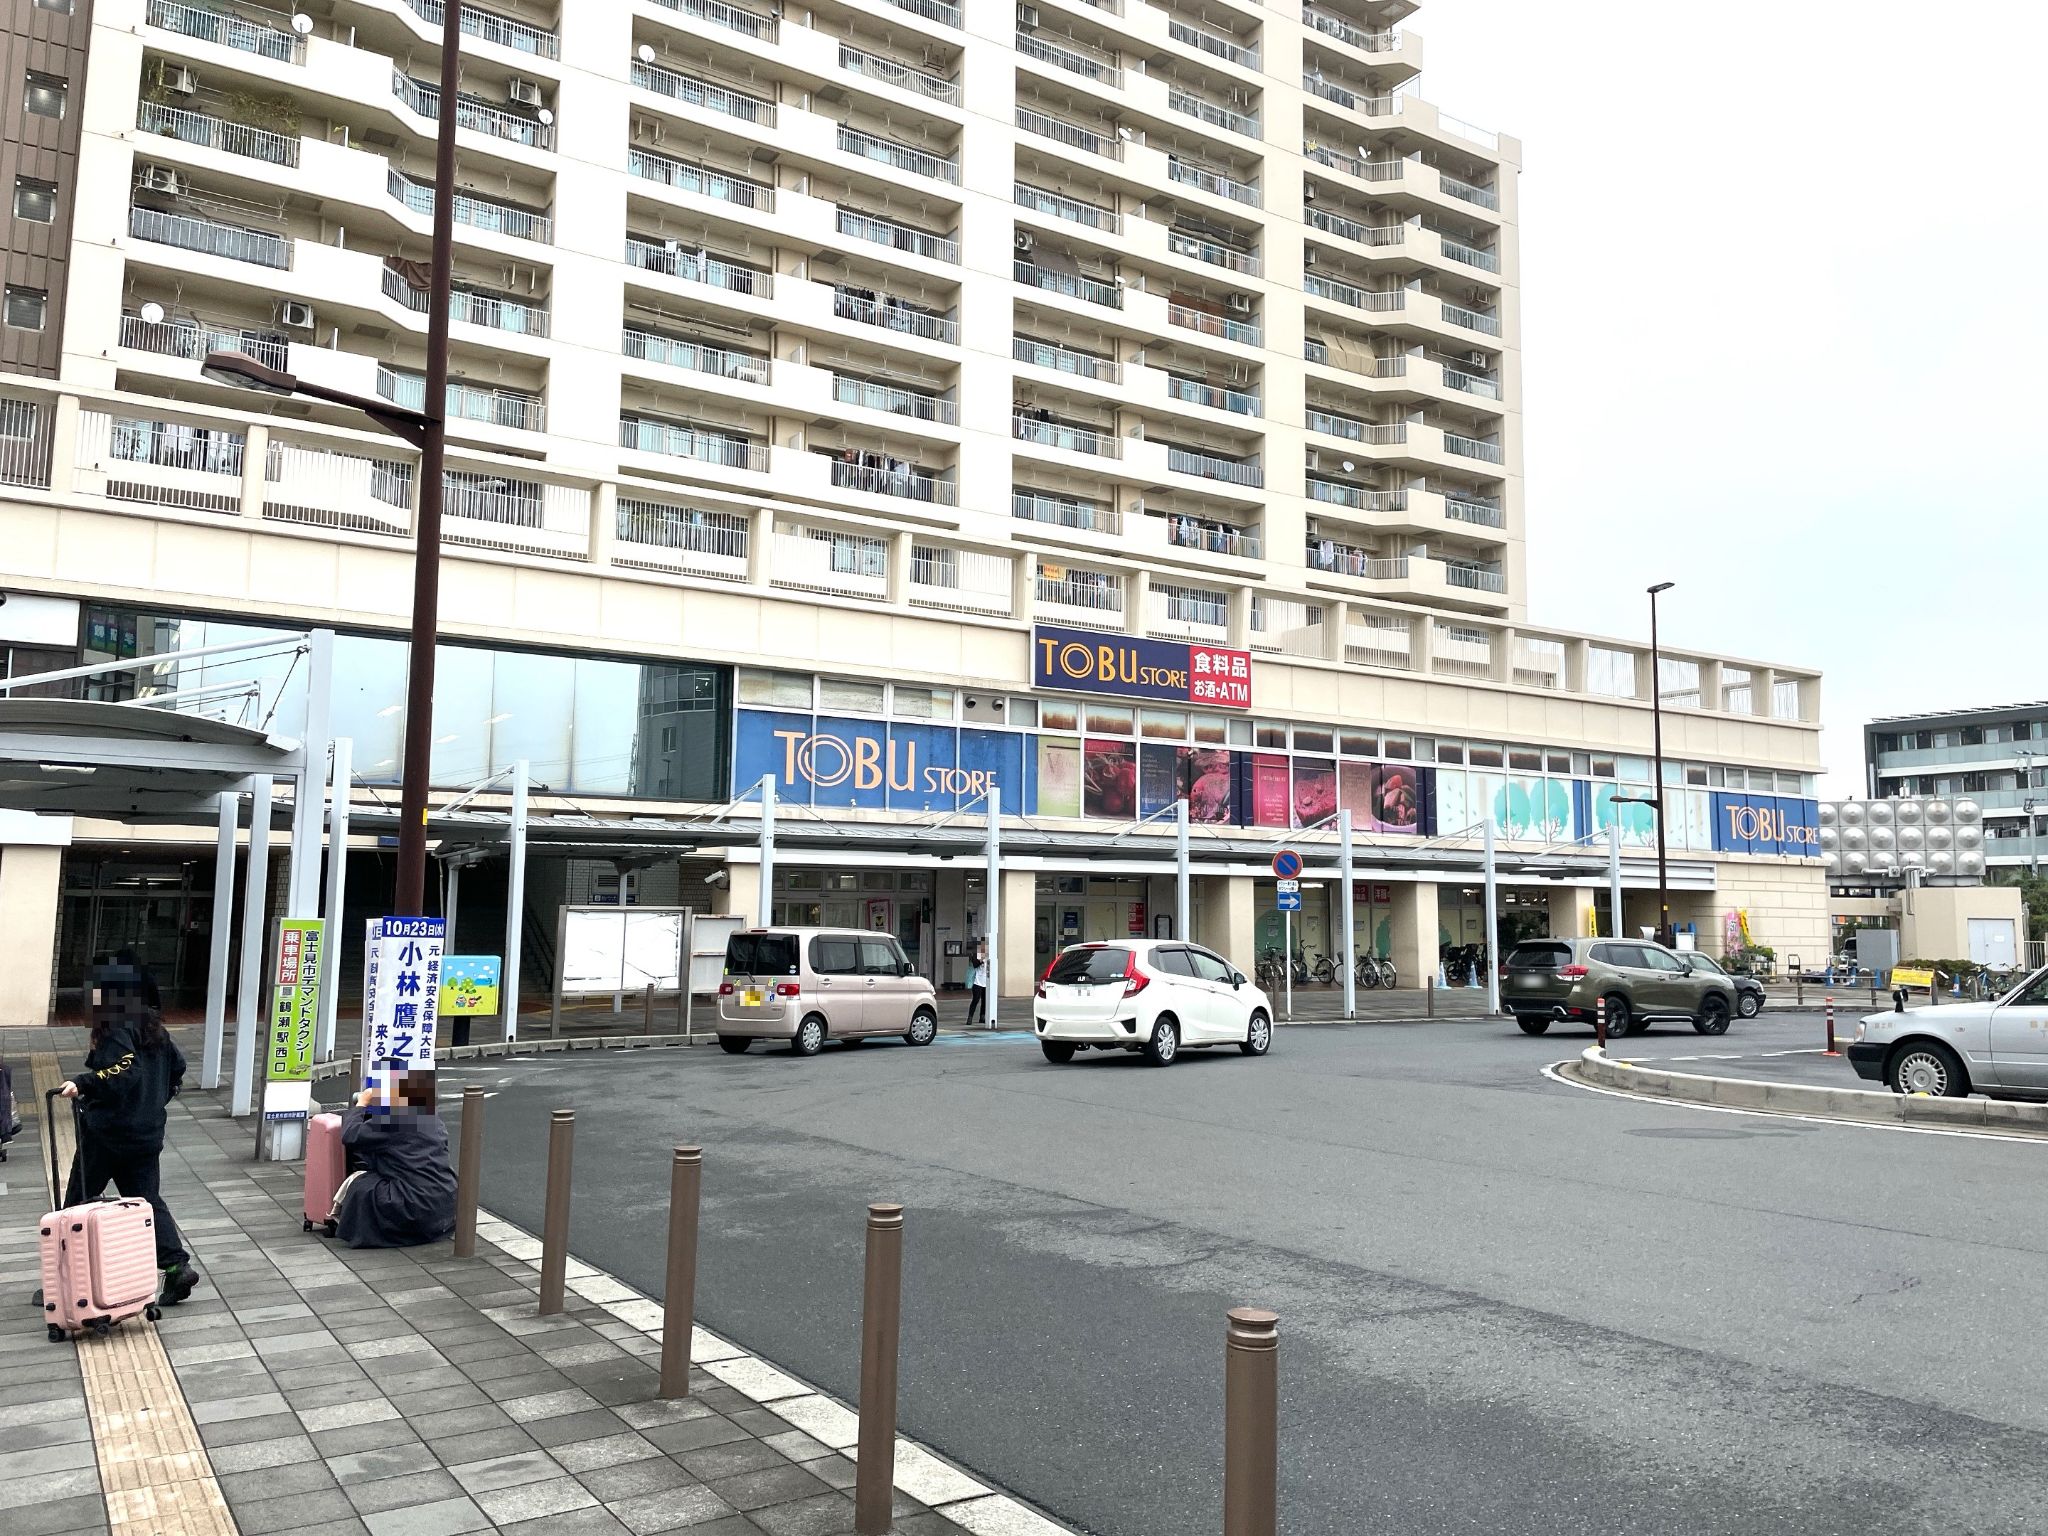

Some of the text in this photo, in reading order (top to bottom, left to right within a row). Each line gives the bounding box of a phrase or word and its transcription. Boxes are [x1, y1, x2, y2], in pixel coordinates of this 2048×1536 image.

[1038, 638, 1188, 690] TOBU STORE
[1193, 651, 1248, 679] 食料品
[773, 728, 916, 792] TOBU
[923, 766, 997, 797] STORE
[1726, 805, 1819, 845] TOBU STORE
[281, 931, 299, 982] 乗車場所
[295, 930, 320, 1062] 富士見市デマンドタクシー
[390, 941, 423, 1058] 小林鷹之
[420, 945, 440, 1059] 元経済安全保障大臣
[274, 1001, 292, 1073] 鶴瀬駅西口
[375, 1023, 389, 1057] 来る
